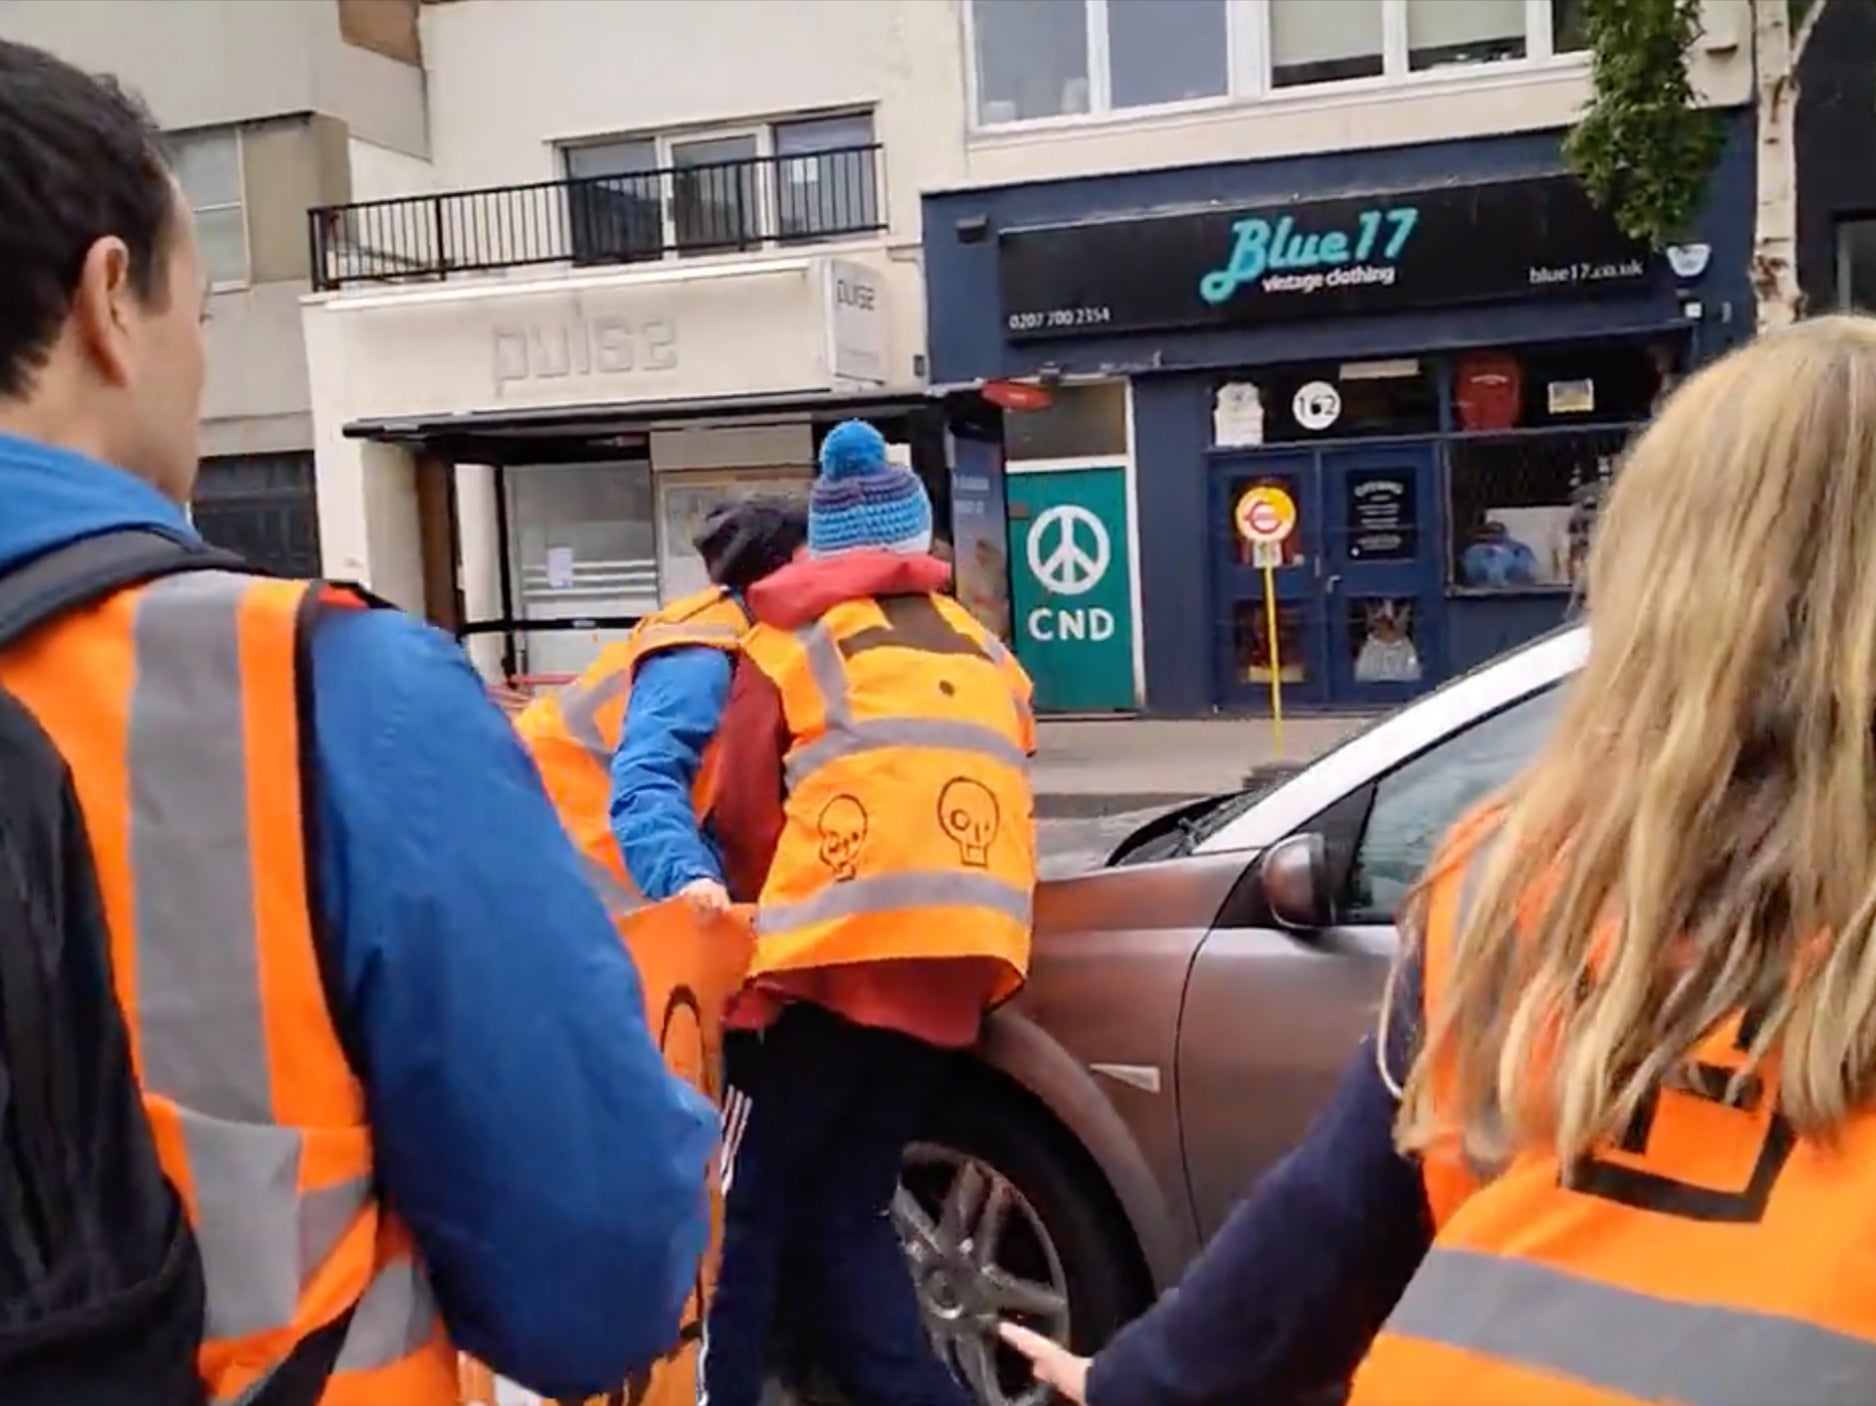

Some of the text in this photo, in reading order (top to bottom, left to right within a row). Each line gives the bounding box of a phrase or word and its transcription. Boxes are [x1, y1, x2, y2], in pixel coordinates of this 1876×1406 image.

[1263, 265, 1395, 292] vintage clothing
[1528, 259, 1643, 284] blue17.co.uk
[1009, 313, 1044, 329] 0207
[1047, 310, 1073, 326] 700
[1028, 607, 1115, 641] CND
